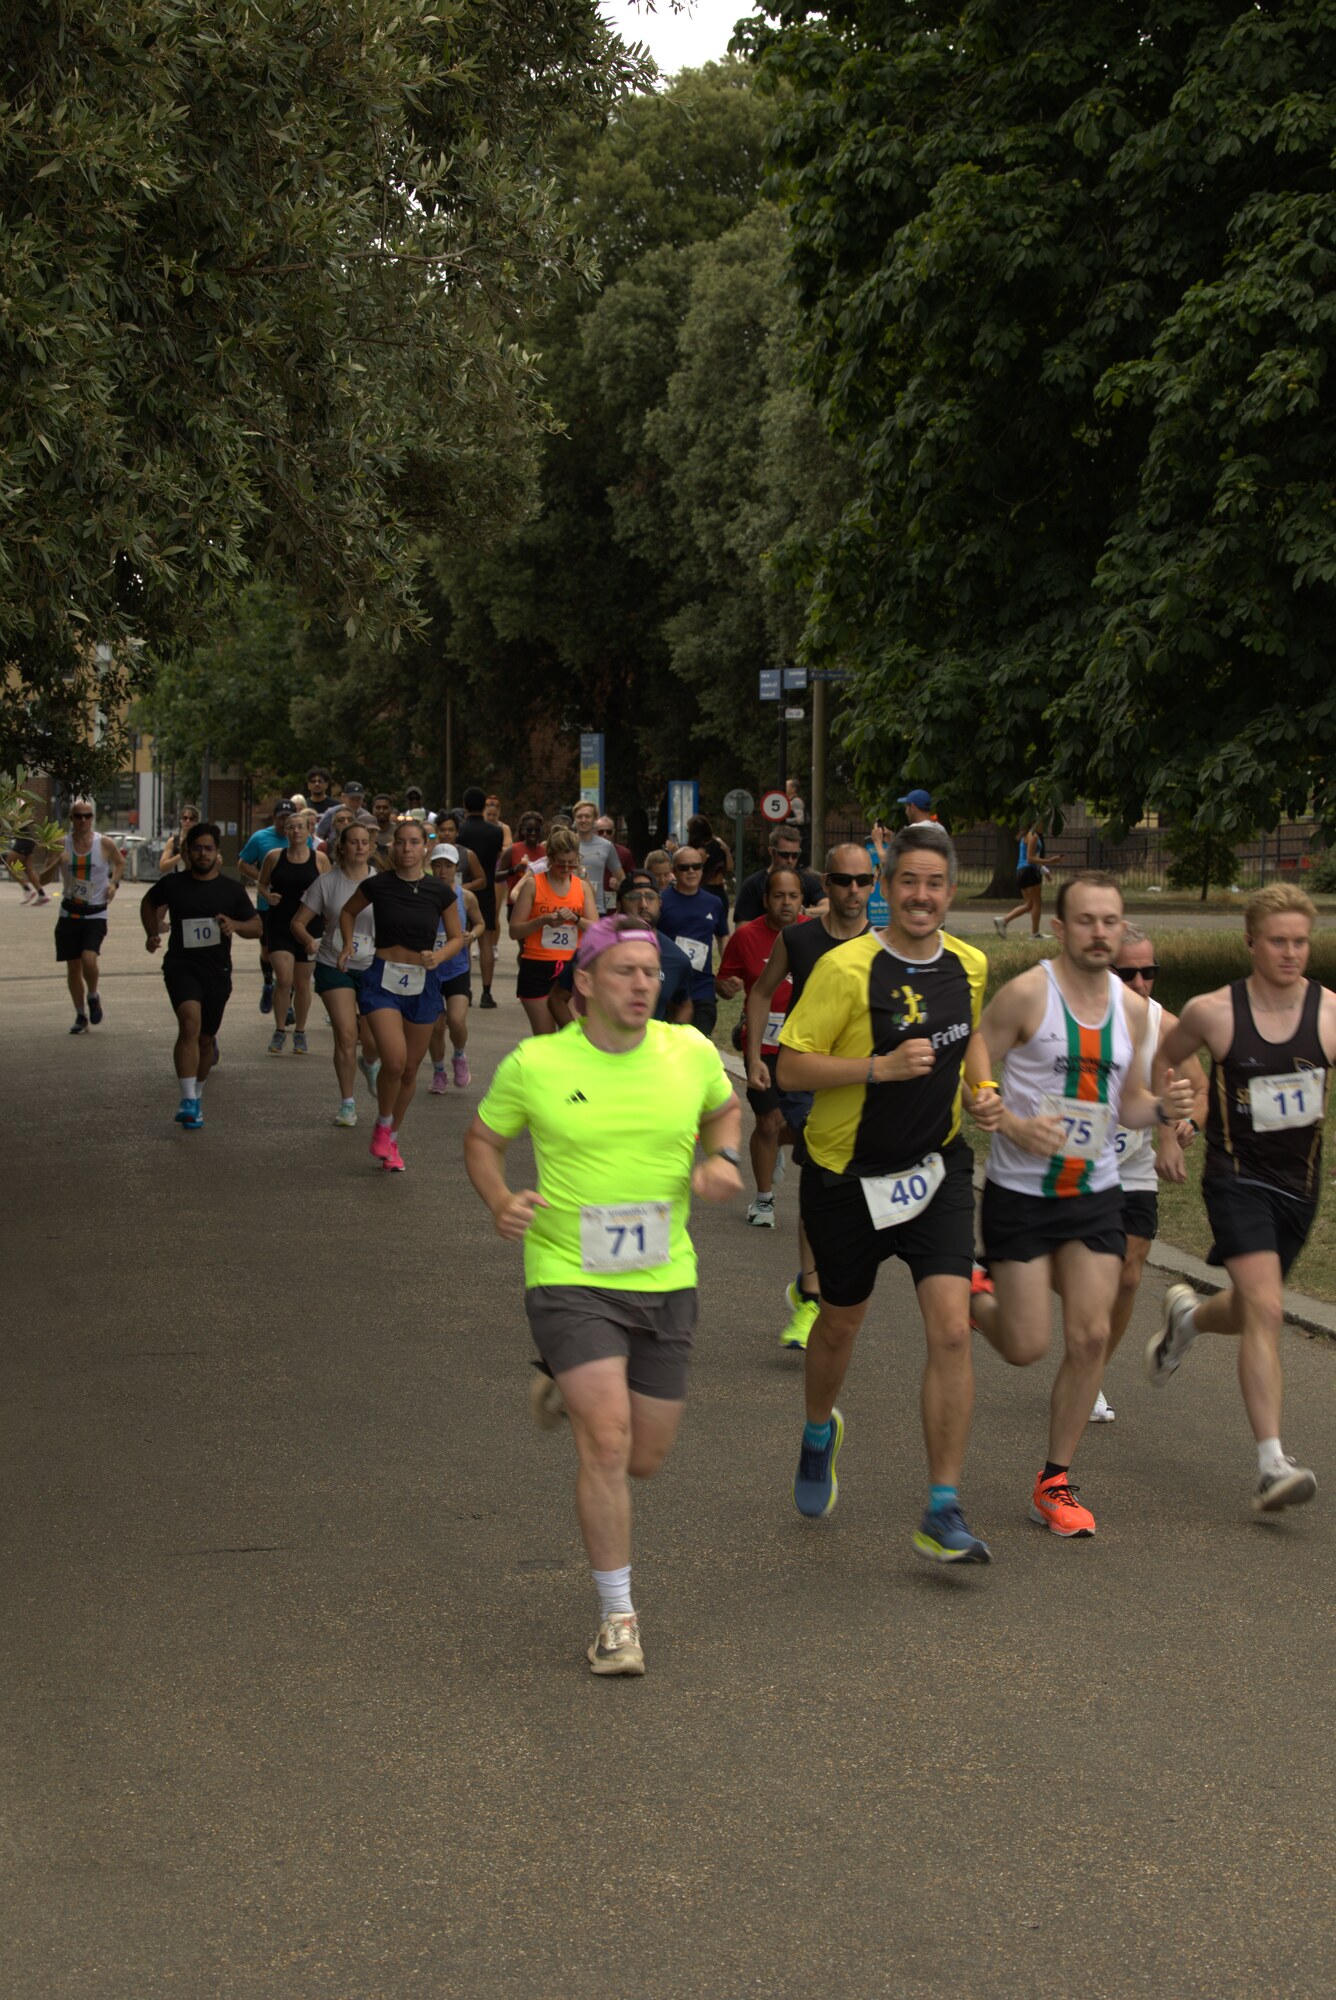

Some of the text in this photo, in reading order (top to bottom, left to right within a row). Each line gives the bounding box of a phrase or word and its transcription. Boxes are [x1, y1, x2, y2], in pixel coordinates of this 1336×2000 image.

[771, 800, 781, 813] 5
[74, 884, 87, 896] 79
[193, 926, 212, 941] 10
[552, 931, 569, 946] 28
[398, 973, 409, 988] 4
[930, 1022, 970, 1049] Frite
[1273, 1089, 1305, 1116] 11
[1063, 1116, 1093, 1145] 75
[891, 1174, 927, 1206] 40
[605, 1222, 645, 1257] 71
